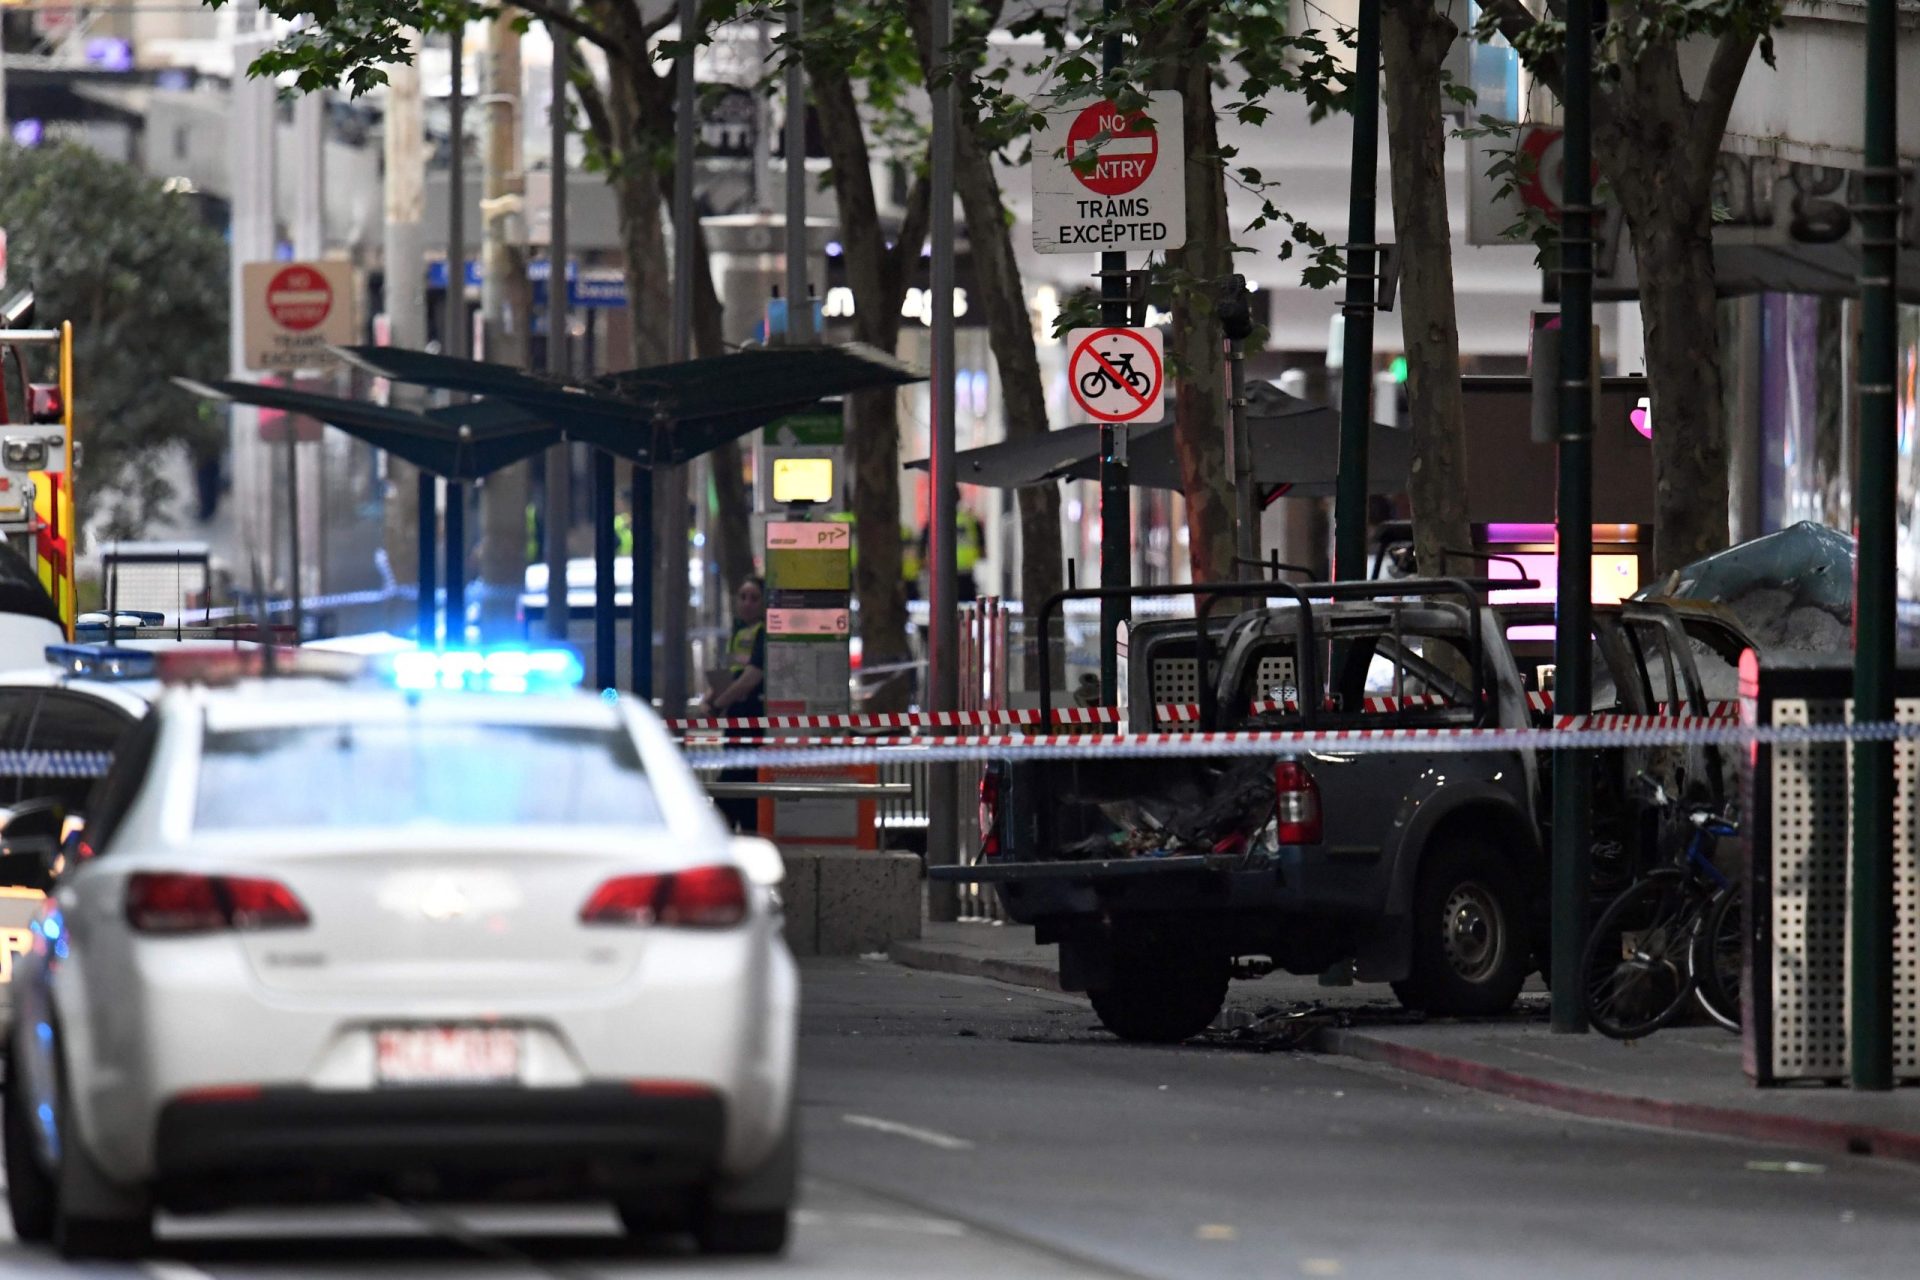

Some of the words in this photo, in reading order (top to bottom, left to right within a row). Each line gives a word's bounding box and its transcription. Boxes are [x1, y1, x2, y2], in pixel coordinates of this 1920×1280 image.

[1098, 114, 1126, 132] NO
[1083, 160, 1146, 180] NTRY
[1077, 198, 1149, 218] TRAMS
[1060, 222, 1167, 244] EXCEPTED
